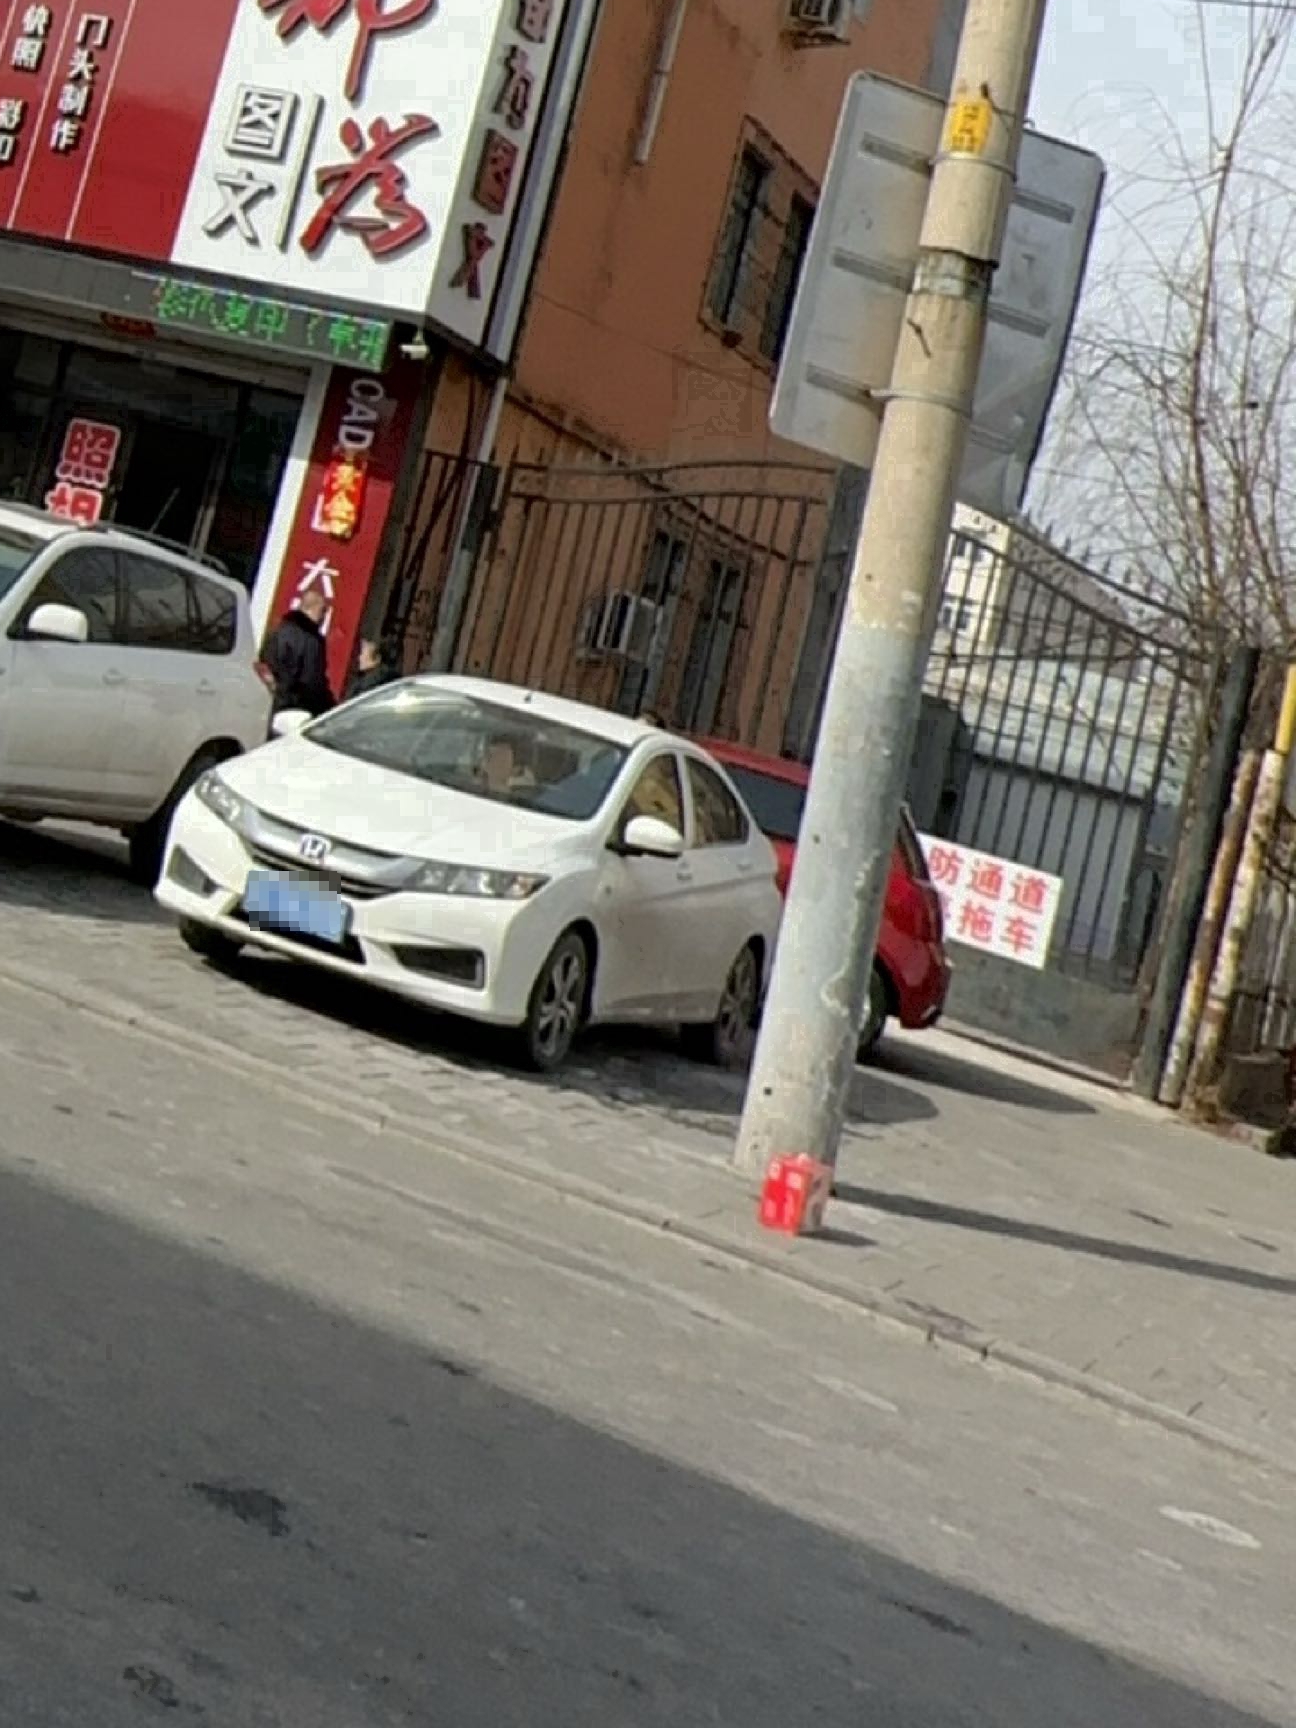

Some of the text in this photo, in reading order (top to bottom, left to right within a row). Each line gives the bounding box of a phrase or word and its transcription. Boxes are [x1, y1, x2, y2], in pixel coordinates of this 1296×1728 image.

[203, 81, 298, 245] 图文
[338, 377, 385, 452] CAD
[942, 900, 1038, 954] 拖车
